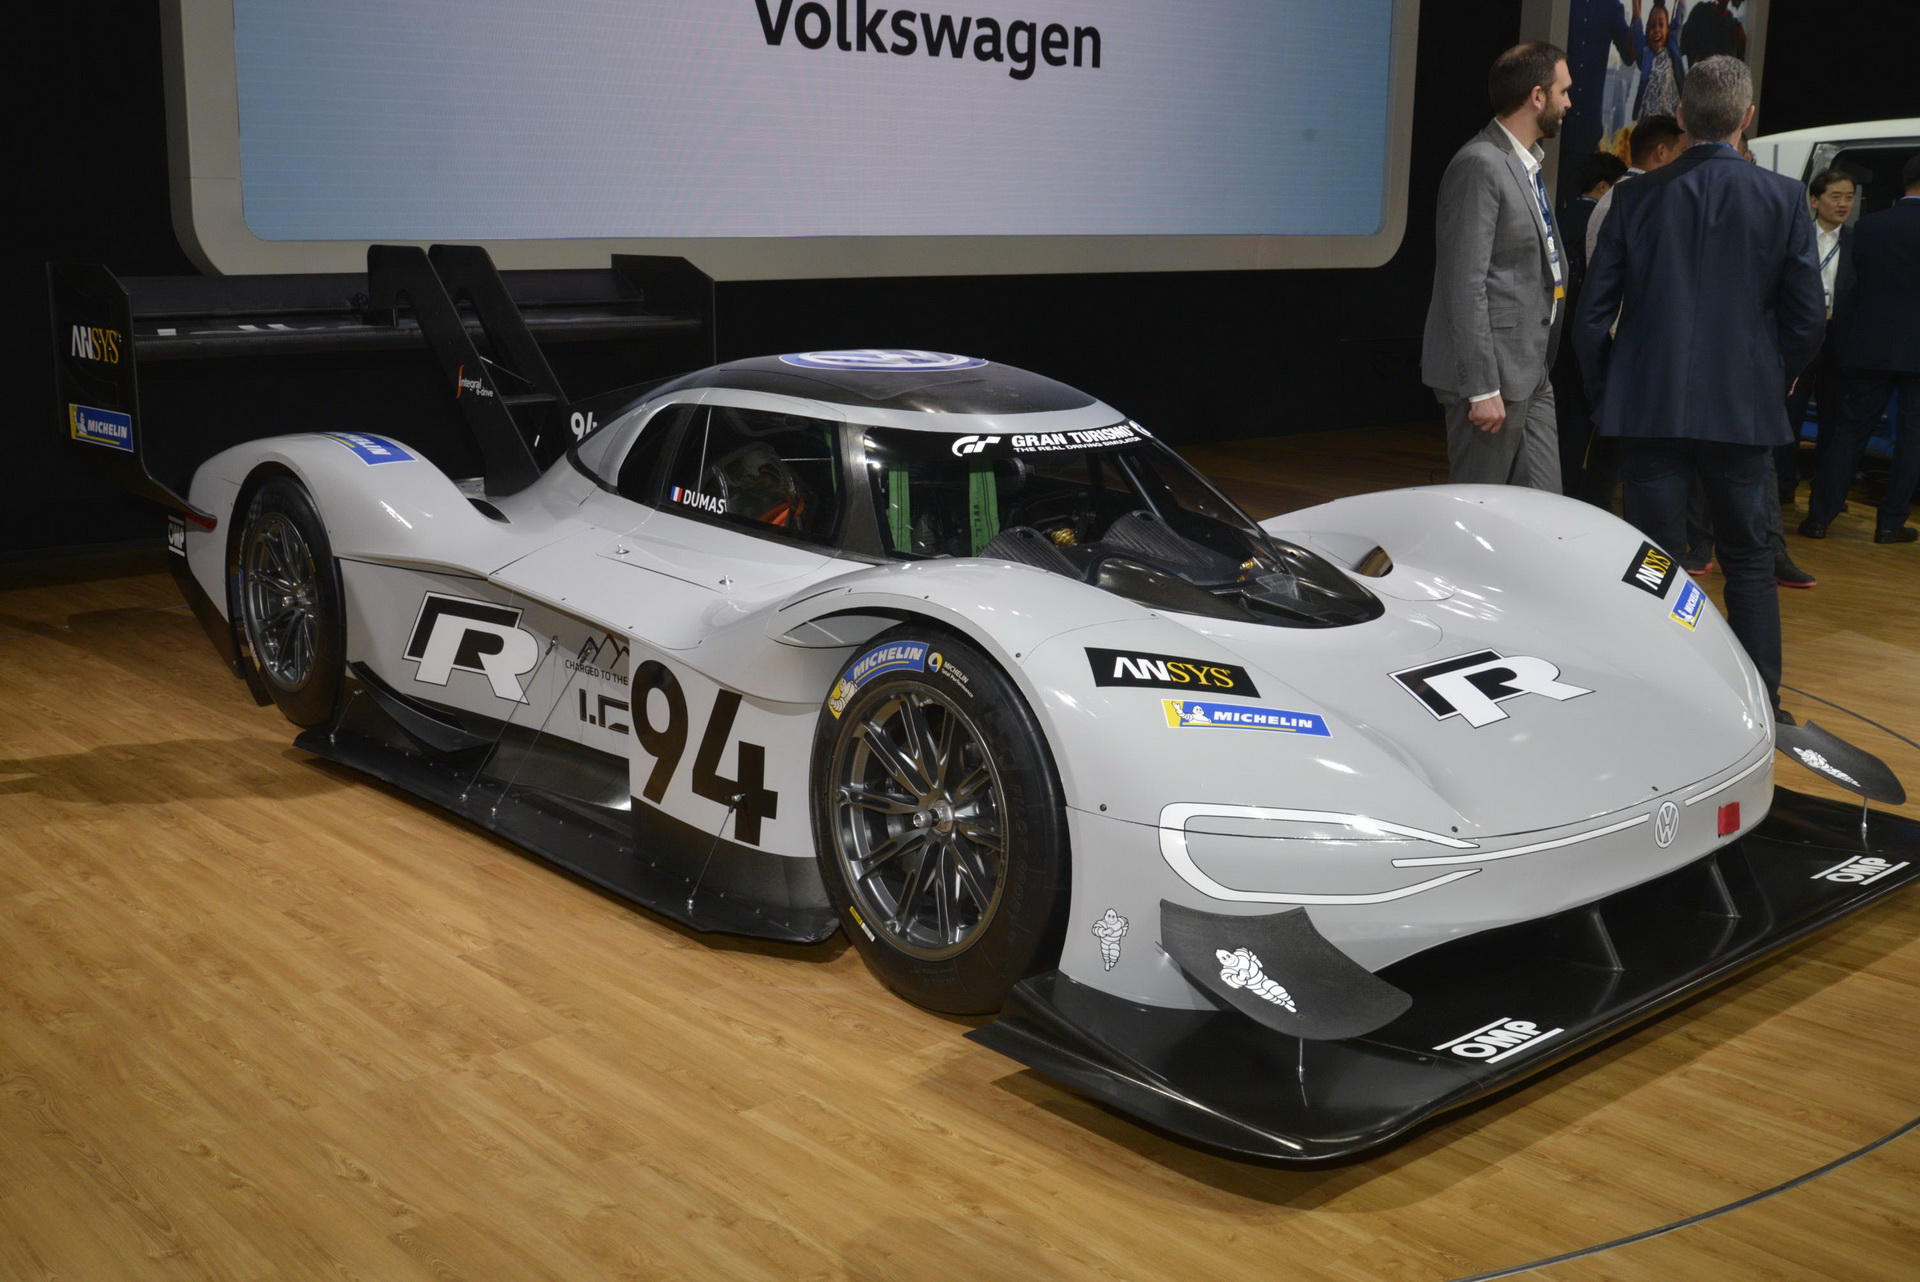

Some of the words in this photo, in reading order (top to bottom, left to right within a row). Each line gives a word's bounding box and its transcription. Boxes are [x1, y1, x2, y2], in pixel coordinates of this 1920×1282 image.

[754, 0, 1101, 80] Volkswagen
[71, 325, 119, 364] ANSYS
[87, 419, 127, 438] MICHELIN
[1011, 433, 1068, 447] GRAN
[1067, 425, 1134, 444] TURISMO
[1065, 442, 1103, 450] DRIVING
[683, 489, 726, 515] DUMAS
[1635, 549, 1671, 590] ANSYS
[402, 590, 538, 705] R
[853, 646, 924, 678] MICHELIN
[565, 660, 600, 678] CHARGED
[600, 670, 611, 681] TO
[613, 674, 629, 686] THE
[943, 661, 969, 684] MICHELIN
[1113, 656, 1235, 689] ANSYS
[1387, 648, 1596, 729] R
[1213, 711, 1313, 729] MICHELIN
[631, 659, 779, 847] 94
[1825, 857, 1893, 882] OMP
[1450, 1020, 1542, 1058] OMP
